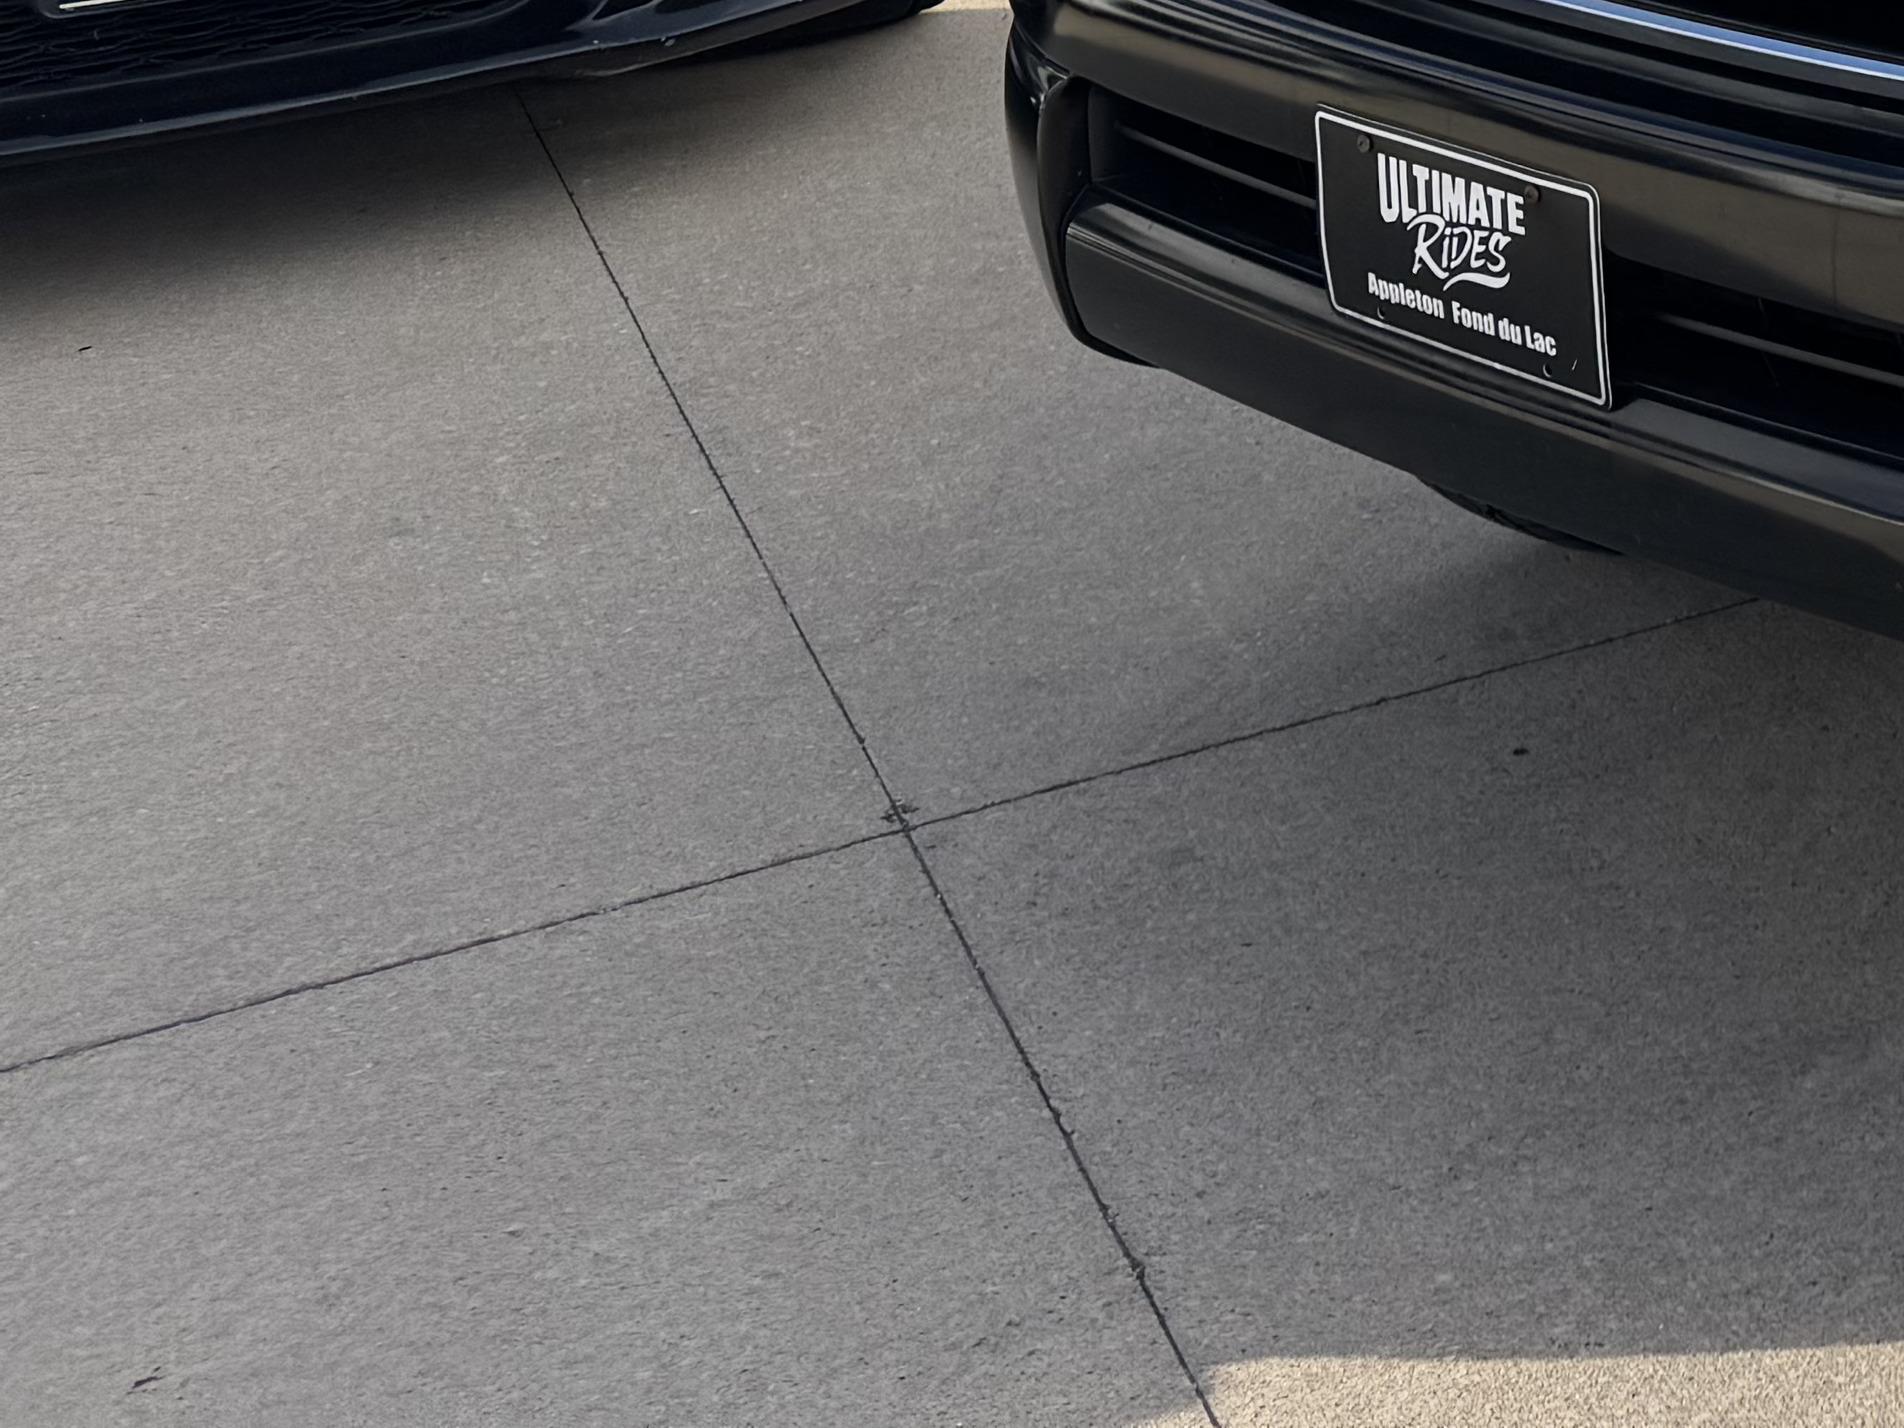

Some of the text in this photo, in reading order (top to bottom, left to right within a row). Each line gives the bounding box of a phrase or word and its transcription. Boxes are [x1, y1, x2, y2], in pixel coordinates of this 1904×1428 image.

[1377, 152, 1526, 236] ULTIMATE
[1367, 271, 1557, 357] Appleton Fond du Lac
